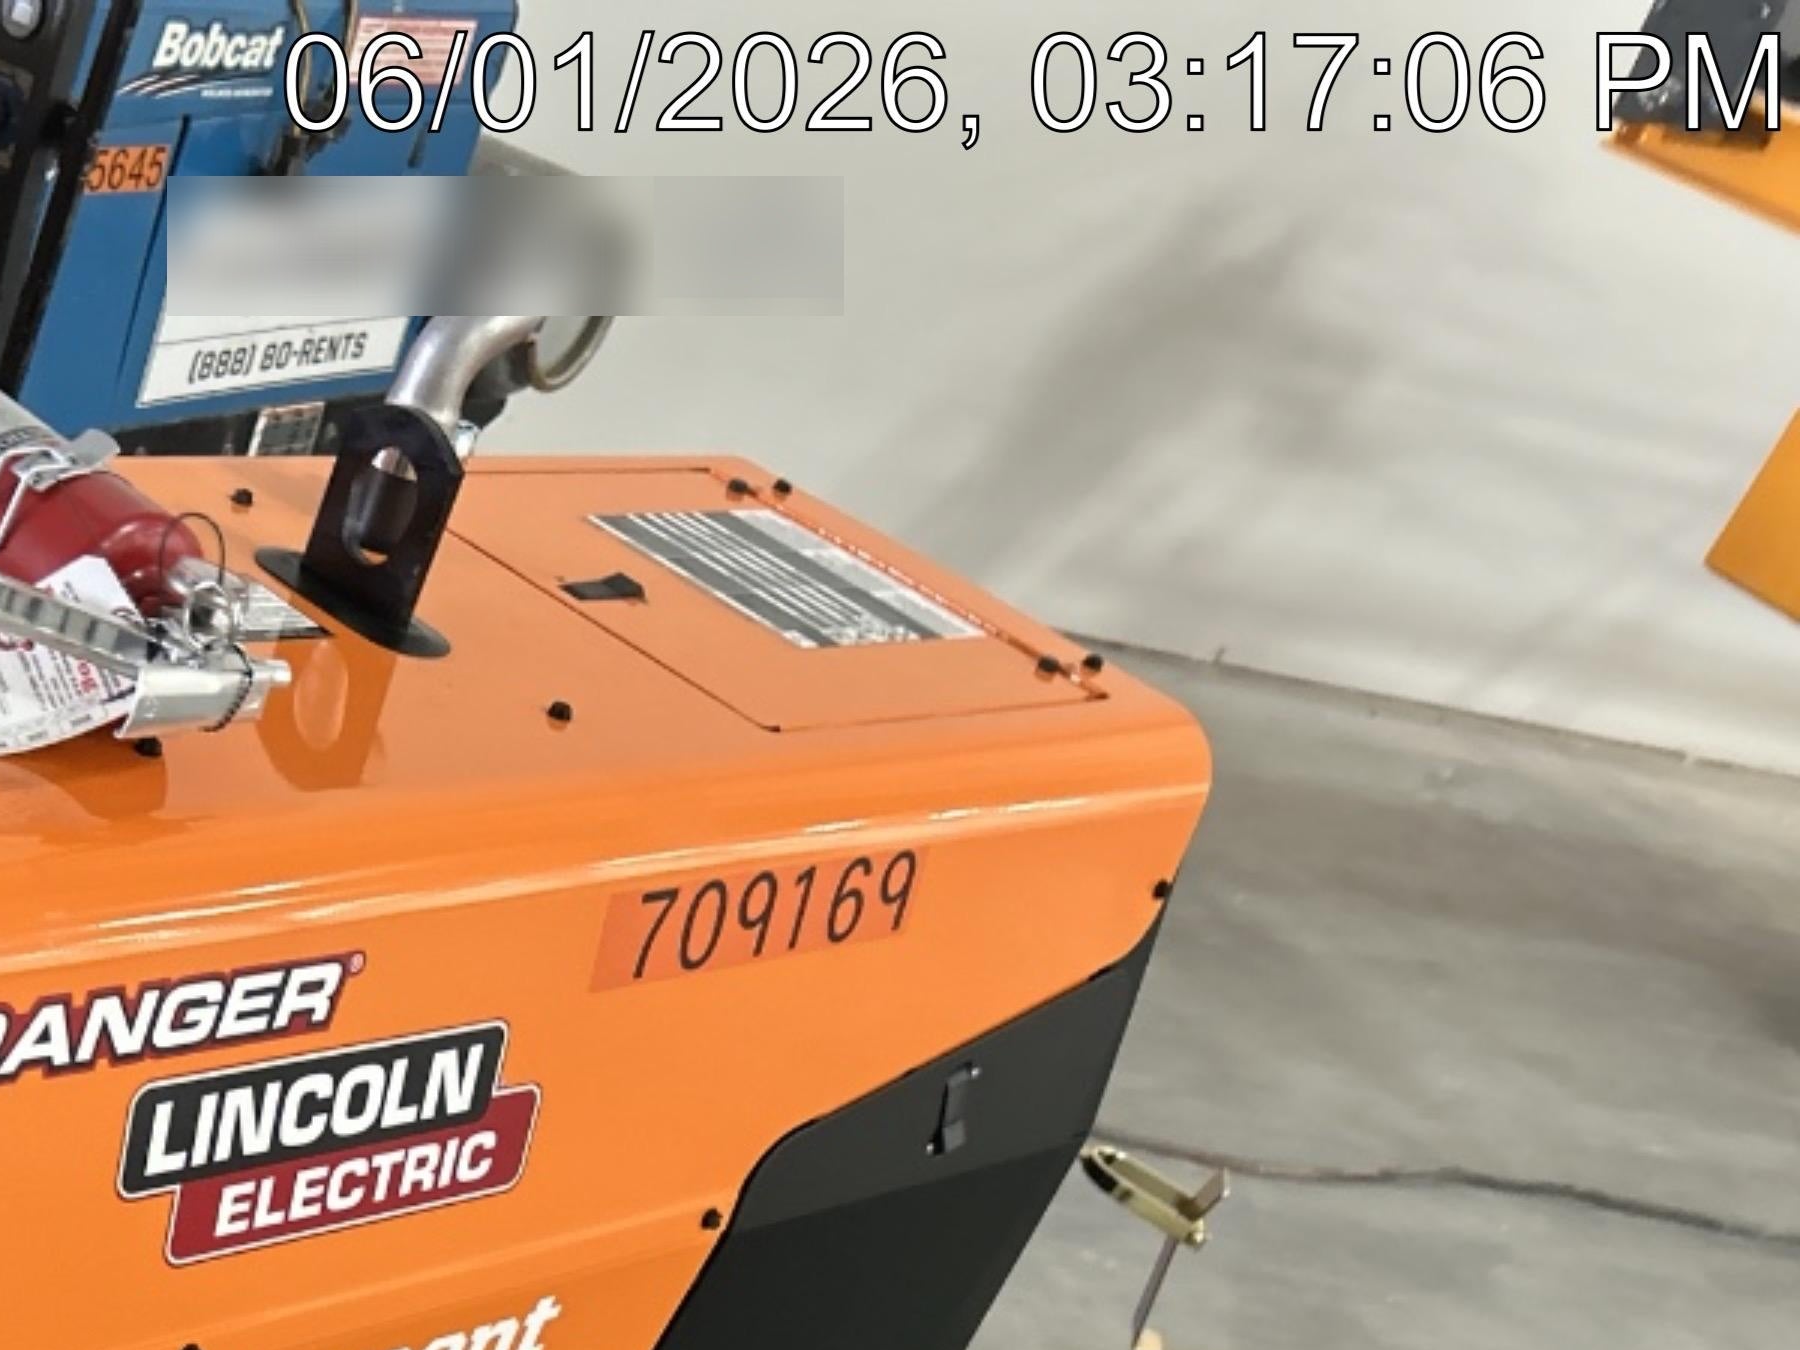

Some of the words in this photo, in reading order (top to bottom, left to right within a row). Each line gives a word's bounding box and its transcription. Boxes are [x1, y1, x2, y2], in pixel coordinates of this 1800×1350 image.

[152, 21, 286, 70] Bobcat
[187, 343, 258, 384] (888)
[632, 848, 918, 980] 709169
[143, 1042, 485, 1178] LINCOLN
[212, 1129, 498, 1238] ELECTRIC
